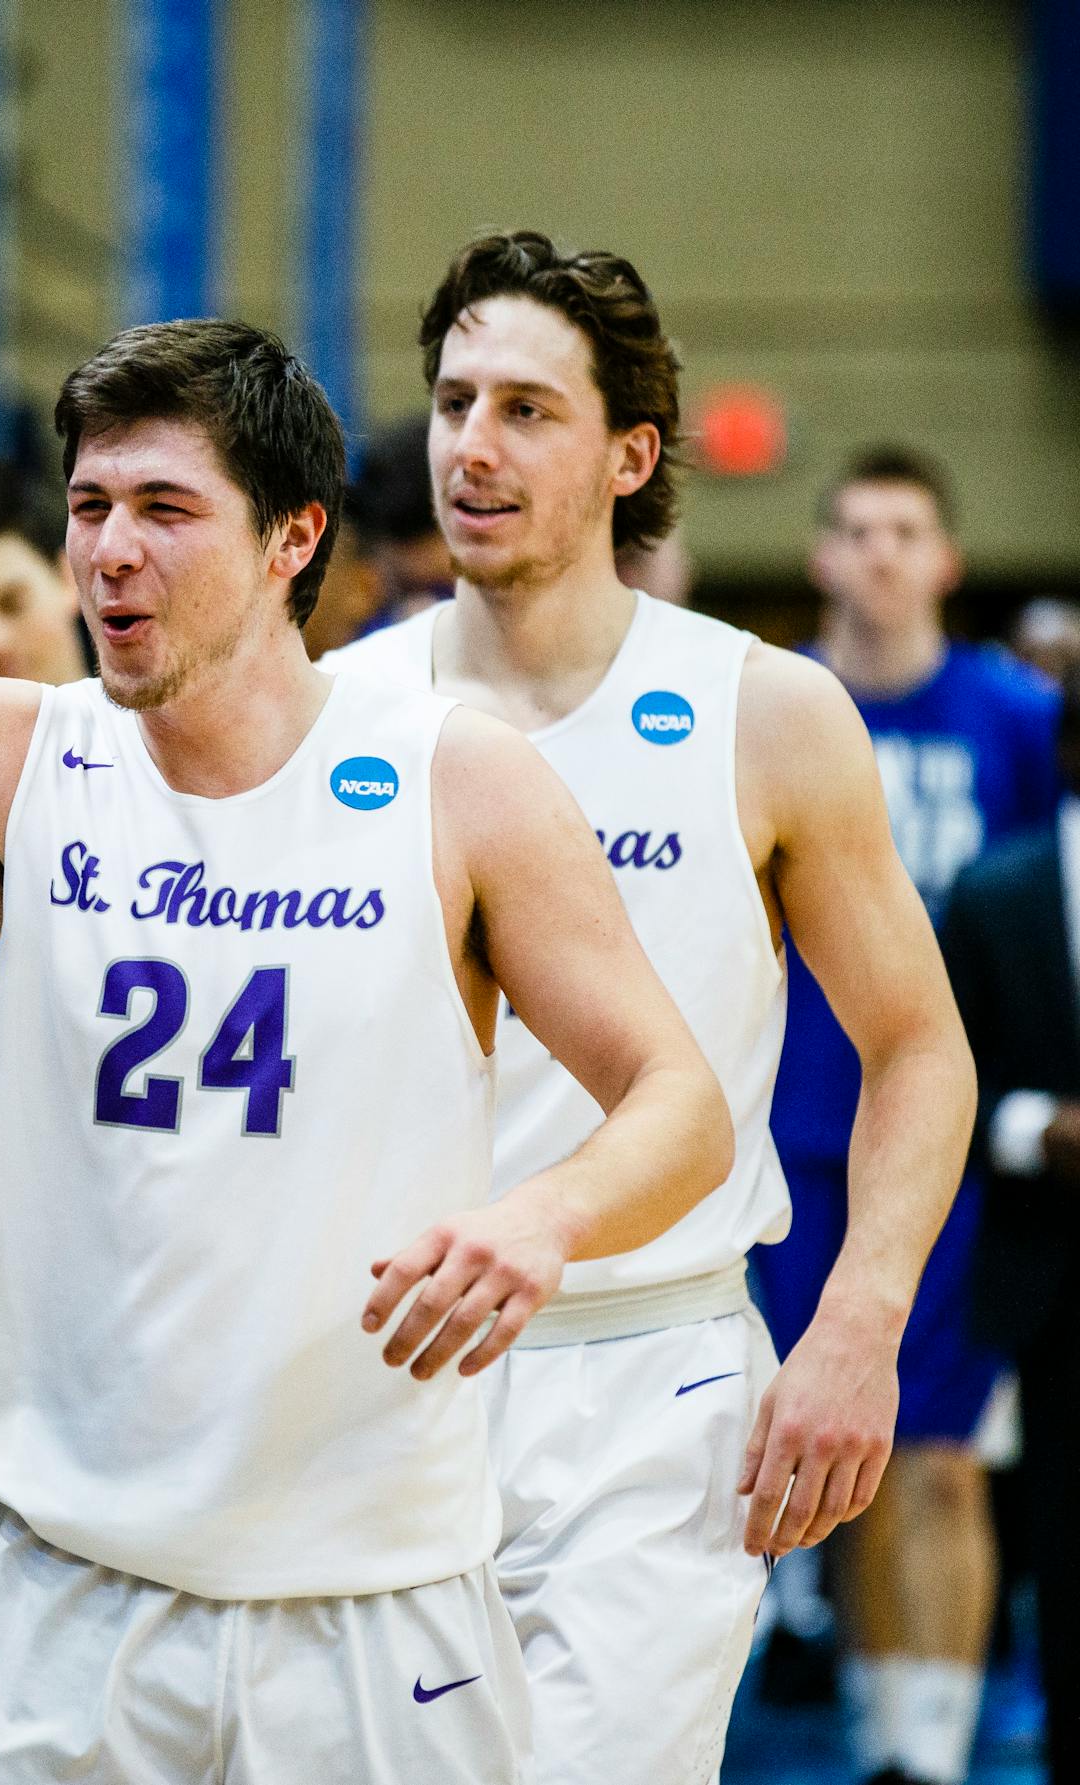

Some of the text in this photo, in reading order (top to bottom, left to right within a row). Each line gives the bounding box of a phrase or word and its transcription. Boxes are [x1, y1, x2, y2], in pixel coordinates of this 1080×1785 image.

[640, 712, 692, 731] NCAA
[338, 779, 395, 797] NCAA
[595, 829, 682, 870] as
[50, 840, 386, 932] St. Thomas
[93, 956, 297, 1138] 24
